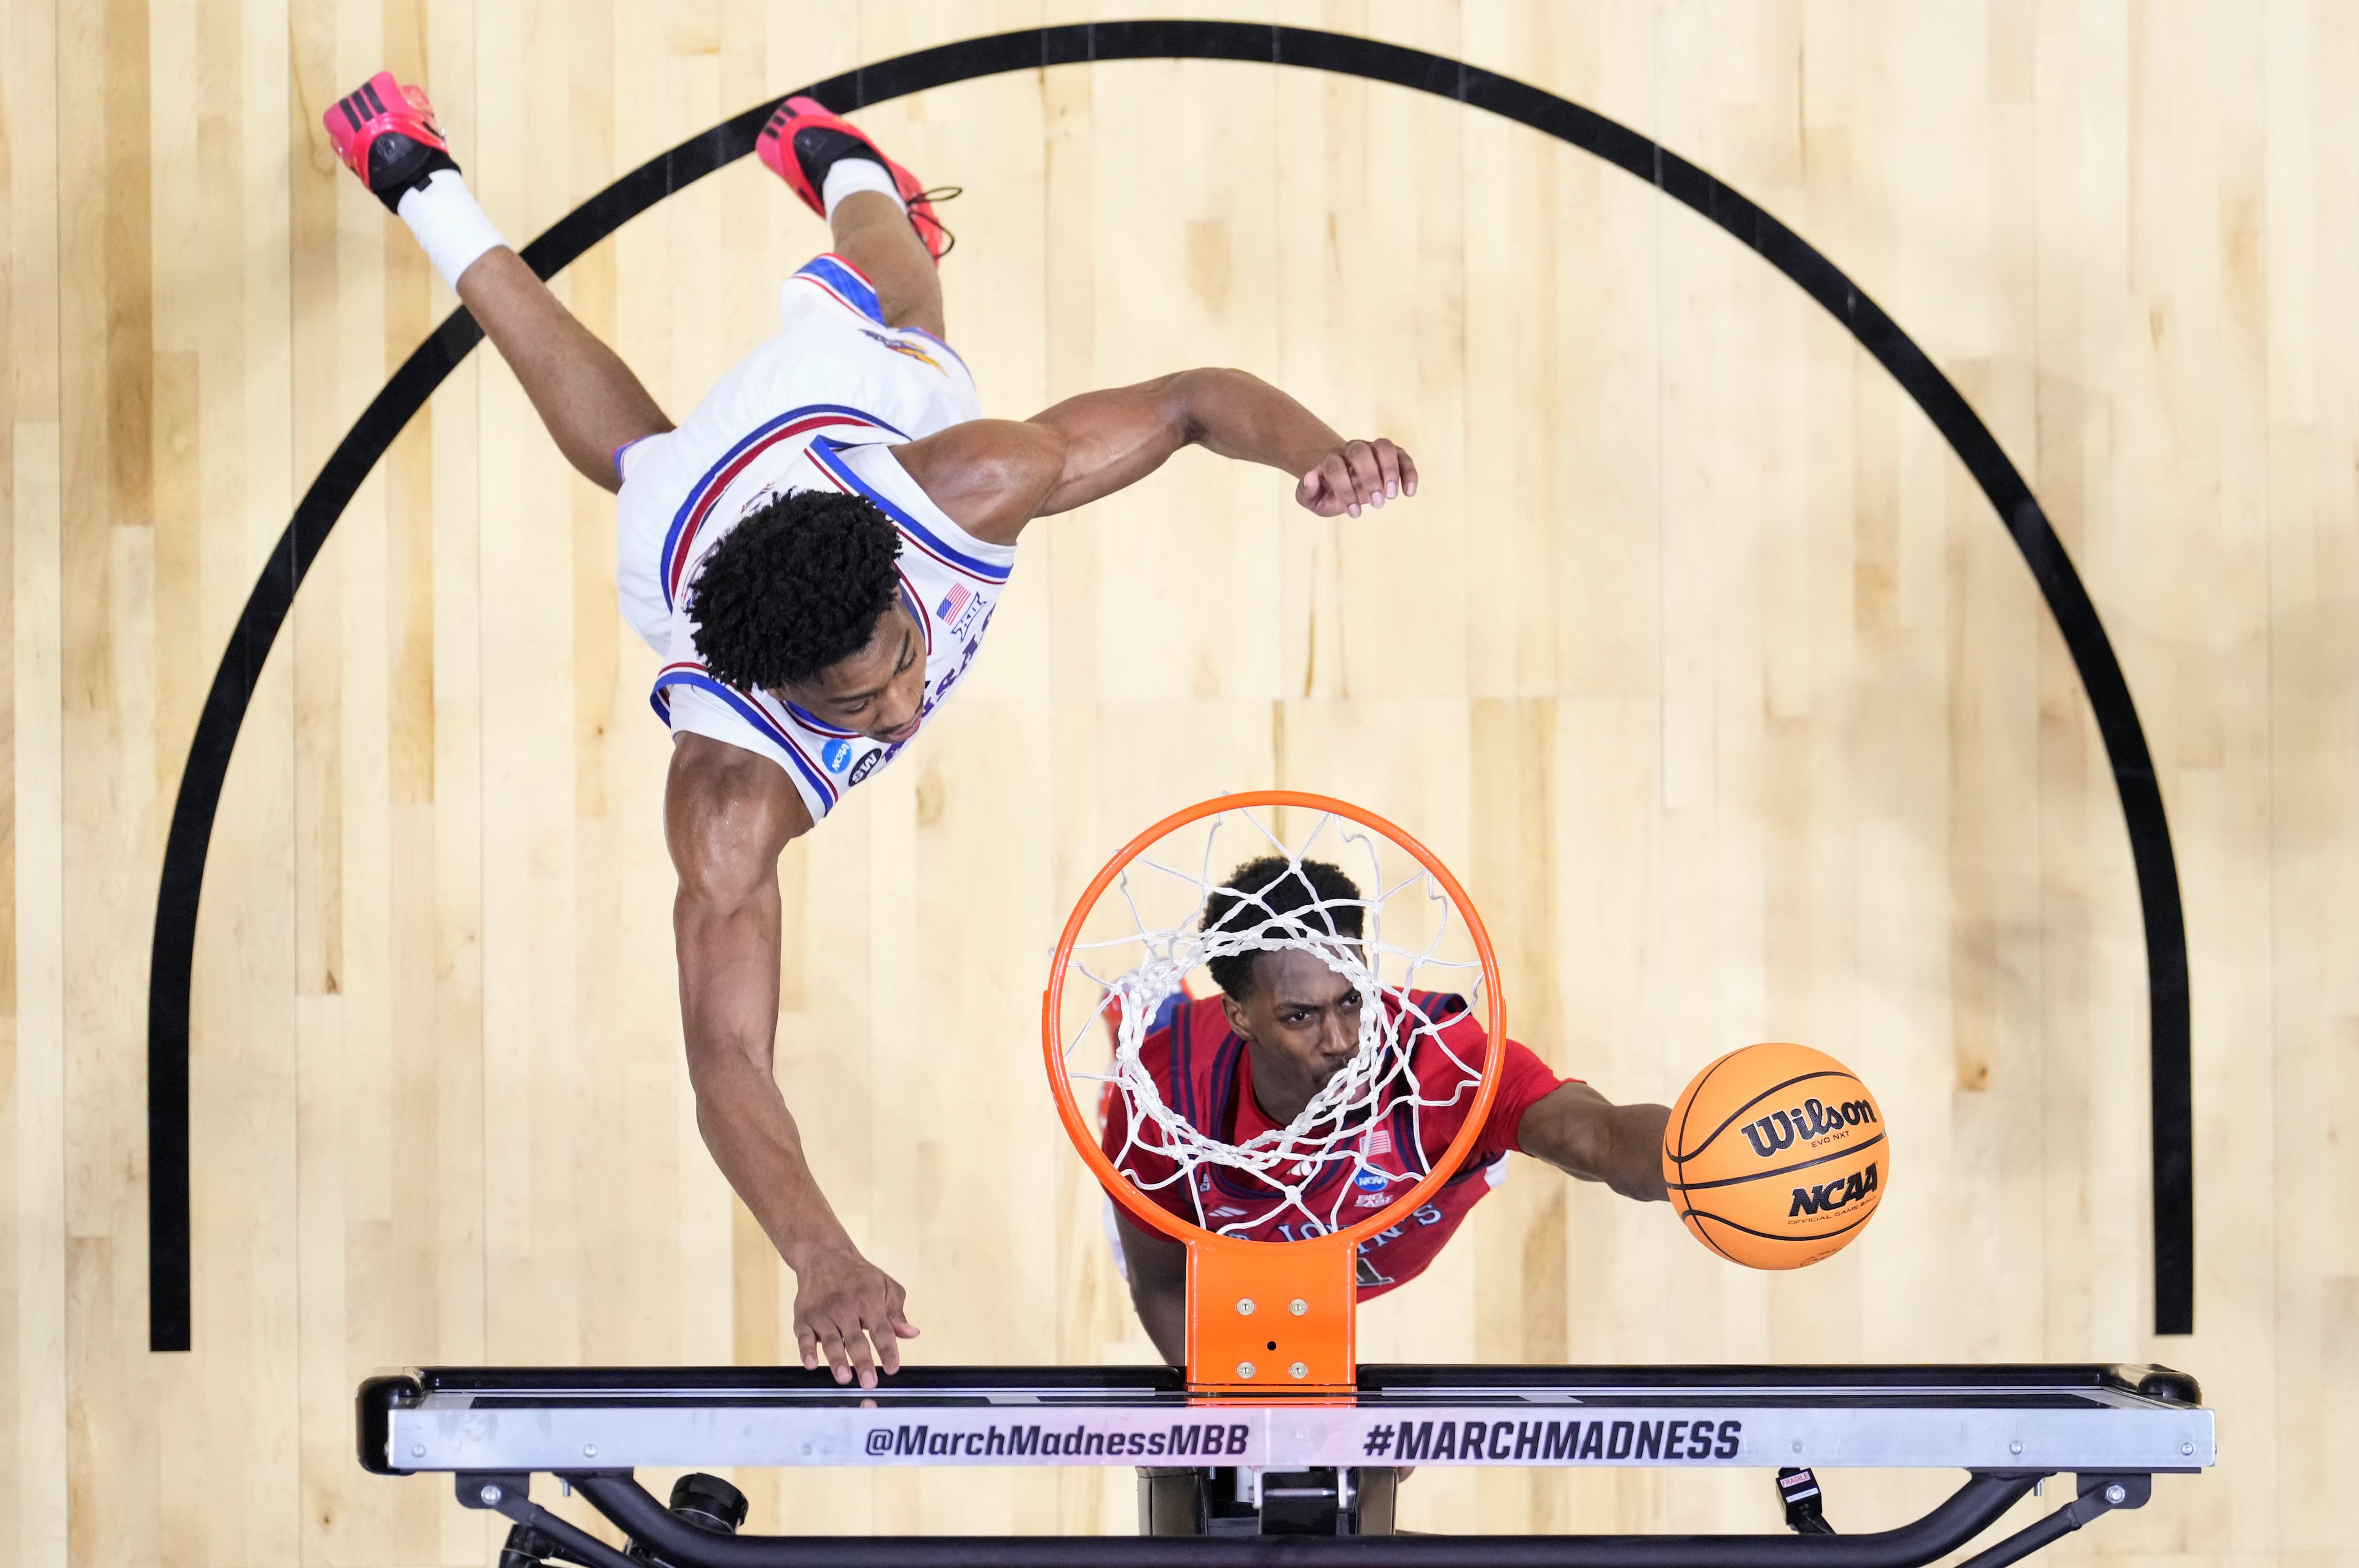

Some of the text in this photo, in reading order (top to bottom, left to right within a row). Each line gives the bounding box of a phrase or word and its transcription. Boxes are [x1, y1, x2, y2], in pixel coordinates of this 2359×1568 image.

[832, 743, 850, 772] NCAA
[1740, 1098, 1877, 1158] Wilson
[1811, 1130, 1850, 1148] EVO NXT
[1358, 1176, 1388, 1186] NCAA
[1788, 1162, 1878, 1217] NCAA
[1788, 1195, 1877, 1225] OFFICIAL GAME BALL
[864, 1424, 1250, 1456] @MarchMadnessMBB
[1363, 1420, 1742, 1460] #MARCHMADNESS
[1782, 1473, 1809, 1487] FRAGILE
